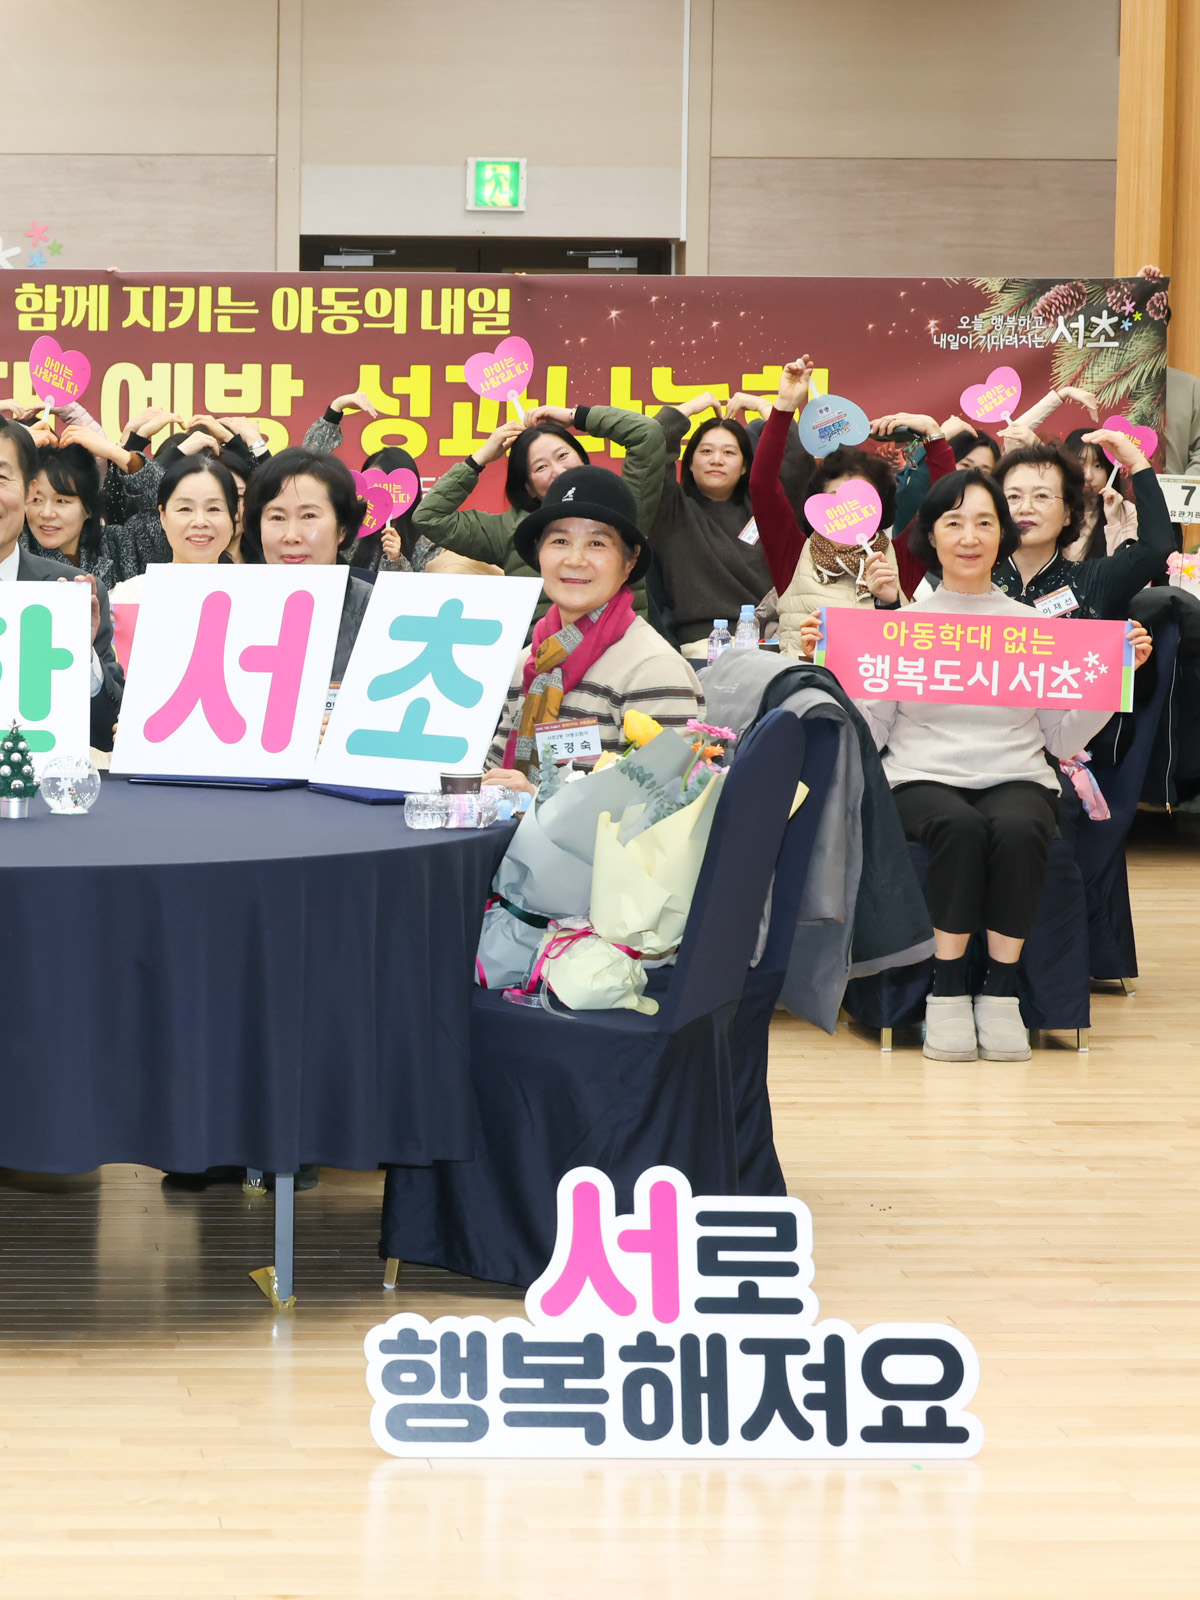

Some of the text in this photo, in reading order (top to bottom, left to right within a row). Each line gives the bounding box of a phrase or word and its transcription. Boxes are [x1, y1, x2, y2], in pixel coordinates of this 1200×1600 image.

[15, 282, 109, 332] 함께
[122, 285, 259, 333] 지키는
[272, 286, 407, 335] 아동의
[421, 287, 511, 335] 내일
[957, 315, 1047, 331] 오늘 행복하고
[933, 333, 1047, 350] 내일이 기다려지는
[1050, 309, 1120, 350] 서초
[32, 364, 79, 396] 사랑입니다
[44, 356, 73, 380] 아이는
[480, 361, 529, 393] 사랑입니다
[483, 356, 516, 378] 아이는
[100, 362, 304, 457] 예방
[825, 499, 862, 520] 아이는
[1181, 485, 1197, 506] 7
[823, 504, 878, 535] 사랑입니다
[882, 620, 1056, 656] 아동학대 없는
[143, 589, 315, 754] 서
[345, 598, 503, 764] 초
[857, 653, 1083, 700] 행복도시 서초
[540, 1180, 804, 1324] 서로
[378, 1327, 970, 1448] 행복해져요
